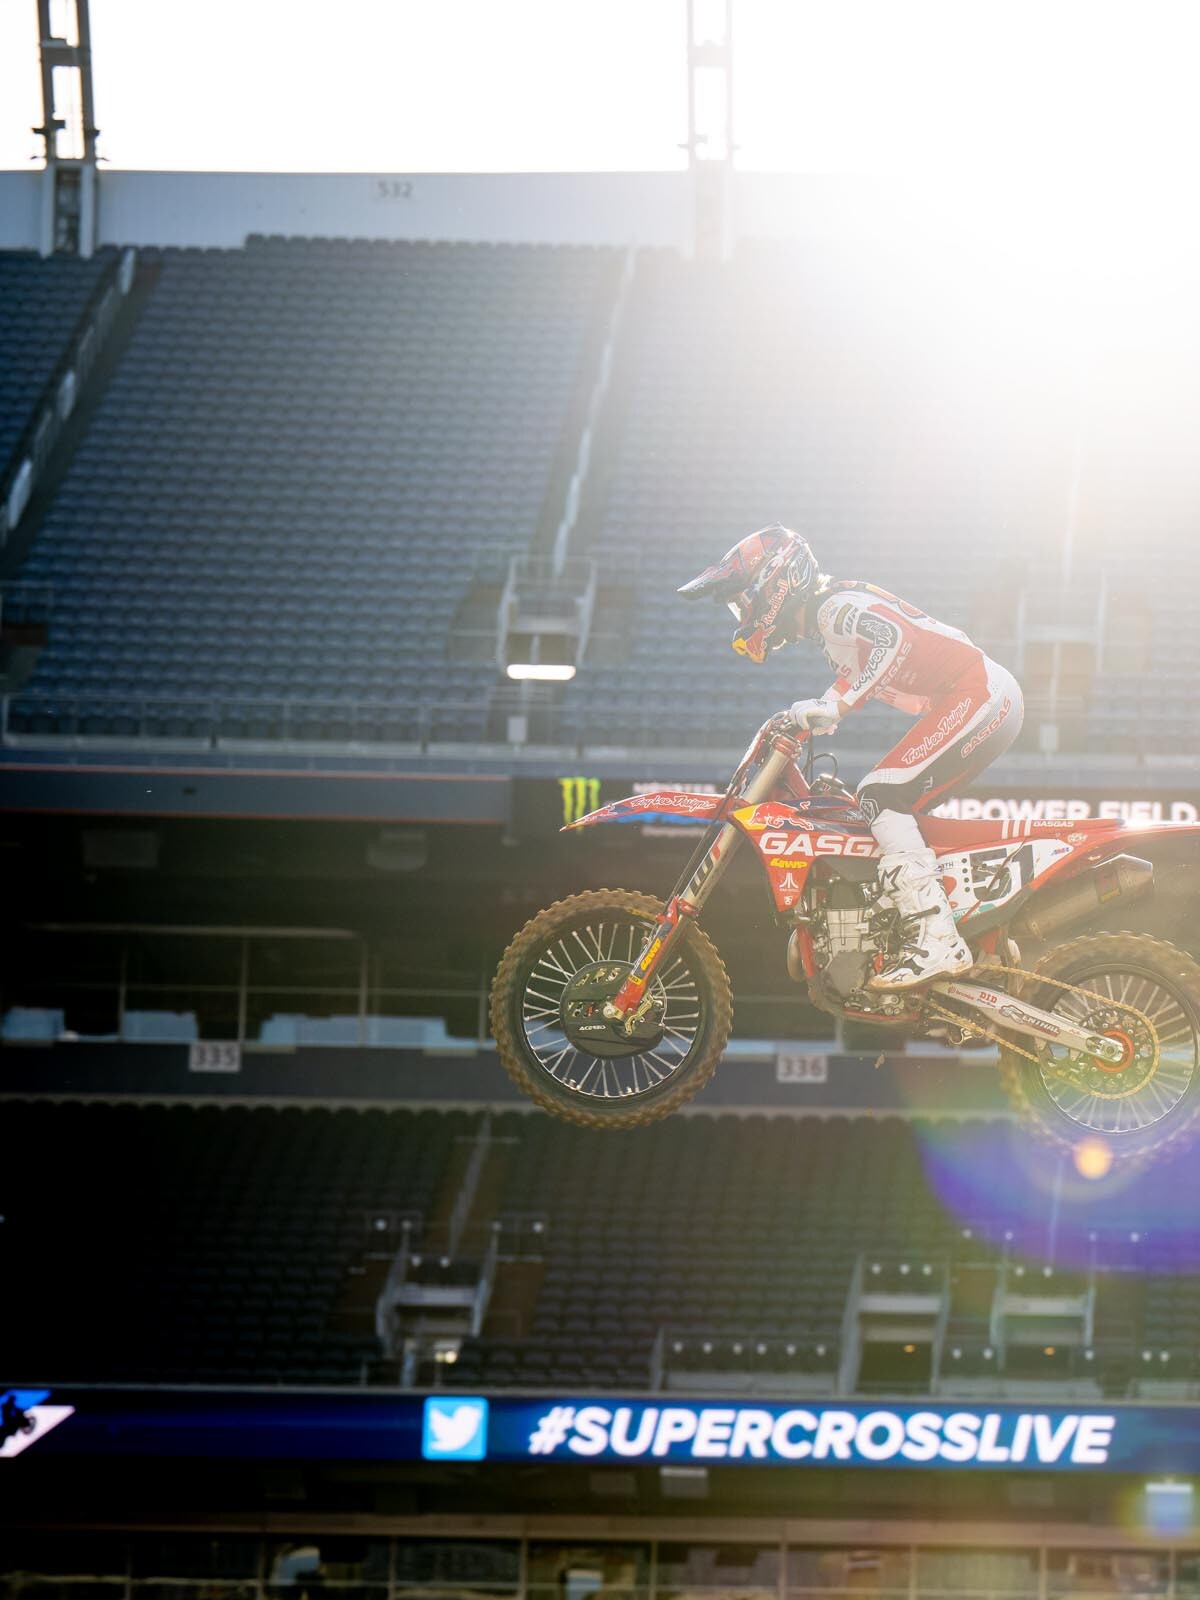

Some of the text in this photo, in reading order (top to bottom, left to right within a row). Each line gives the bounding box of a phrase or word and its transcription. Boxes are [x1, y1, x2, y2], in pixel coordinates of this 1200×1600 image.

[378, 181, 413, 199] 532
[961, 696, 1011, 758] GASGAS
[902, 747, 929, 764] Troy
[924, 731, 945, 750] Lee
[651, 795, 673, 805] Lee
[1099, 801, 1198, 823] FIELD
[1033, 820, 1074, 828] GASGAS
[969, 845, 1034, 902] 51
[979, 991, 998, 1003] DID
[191, 1045, 237, 1068] 335
[528, 1406, 1114, 1463] #SUPERCROSSLIVE
